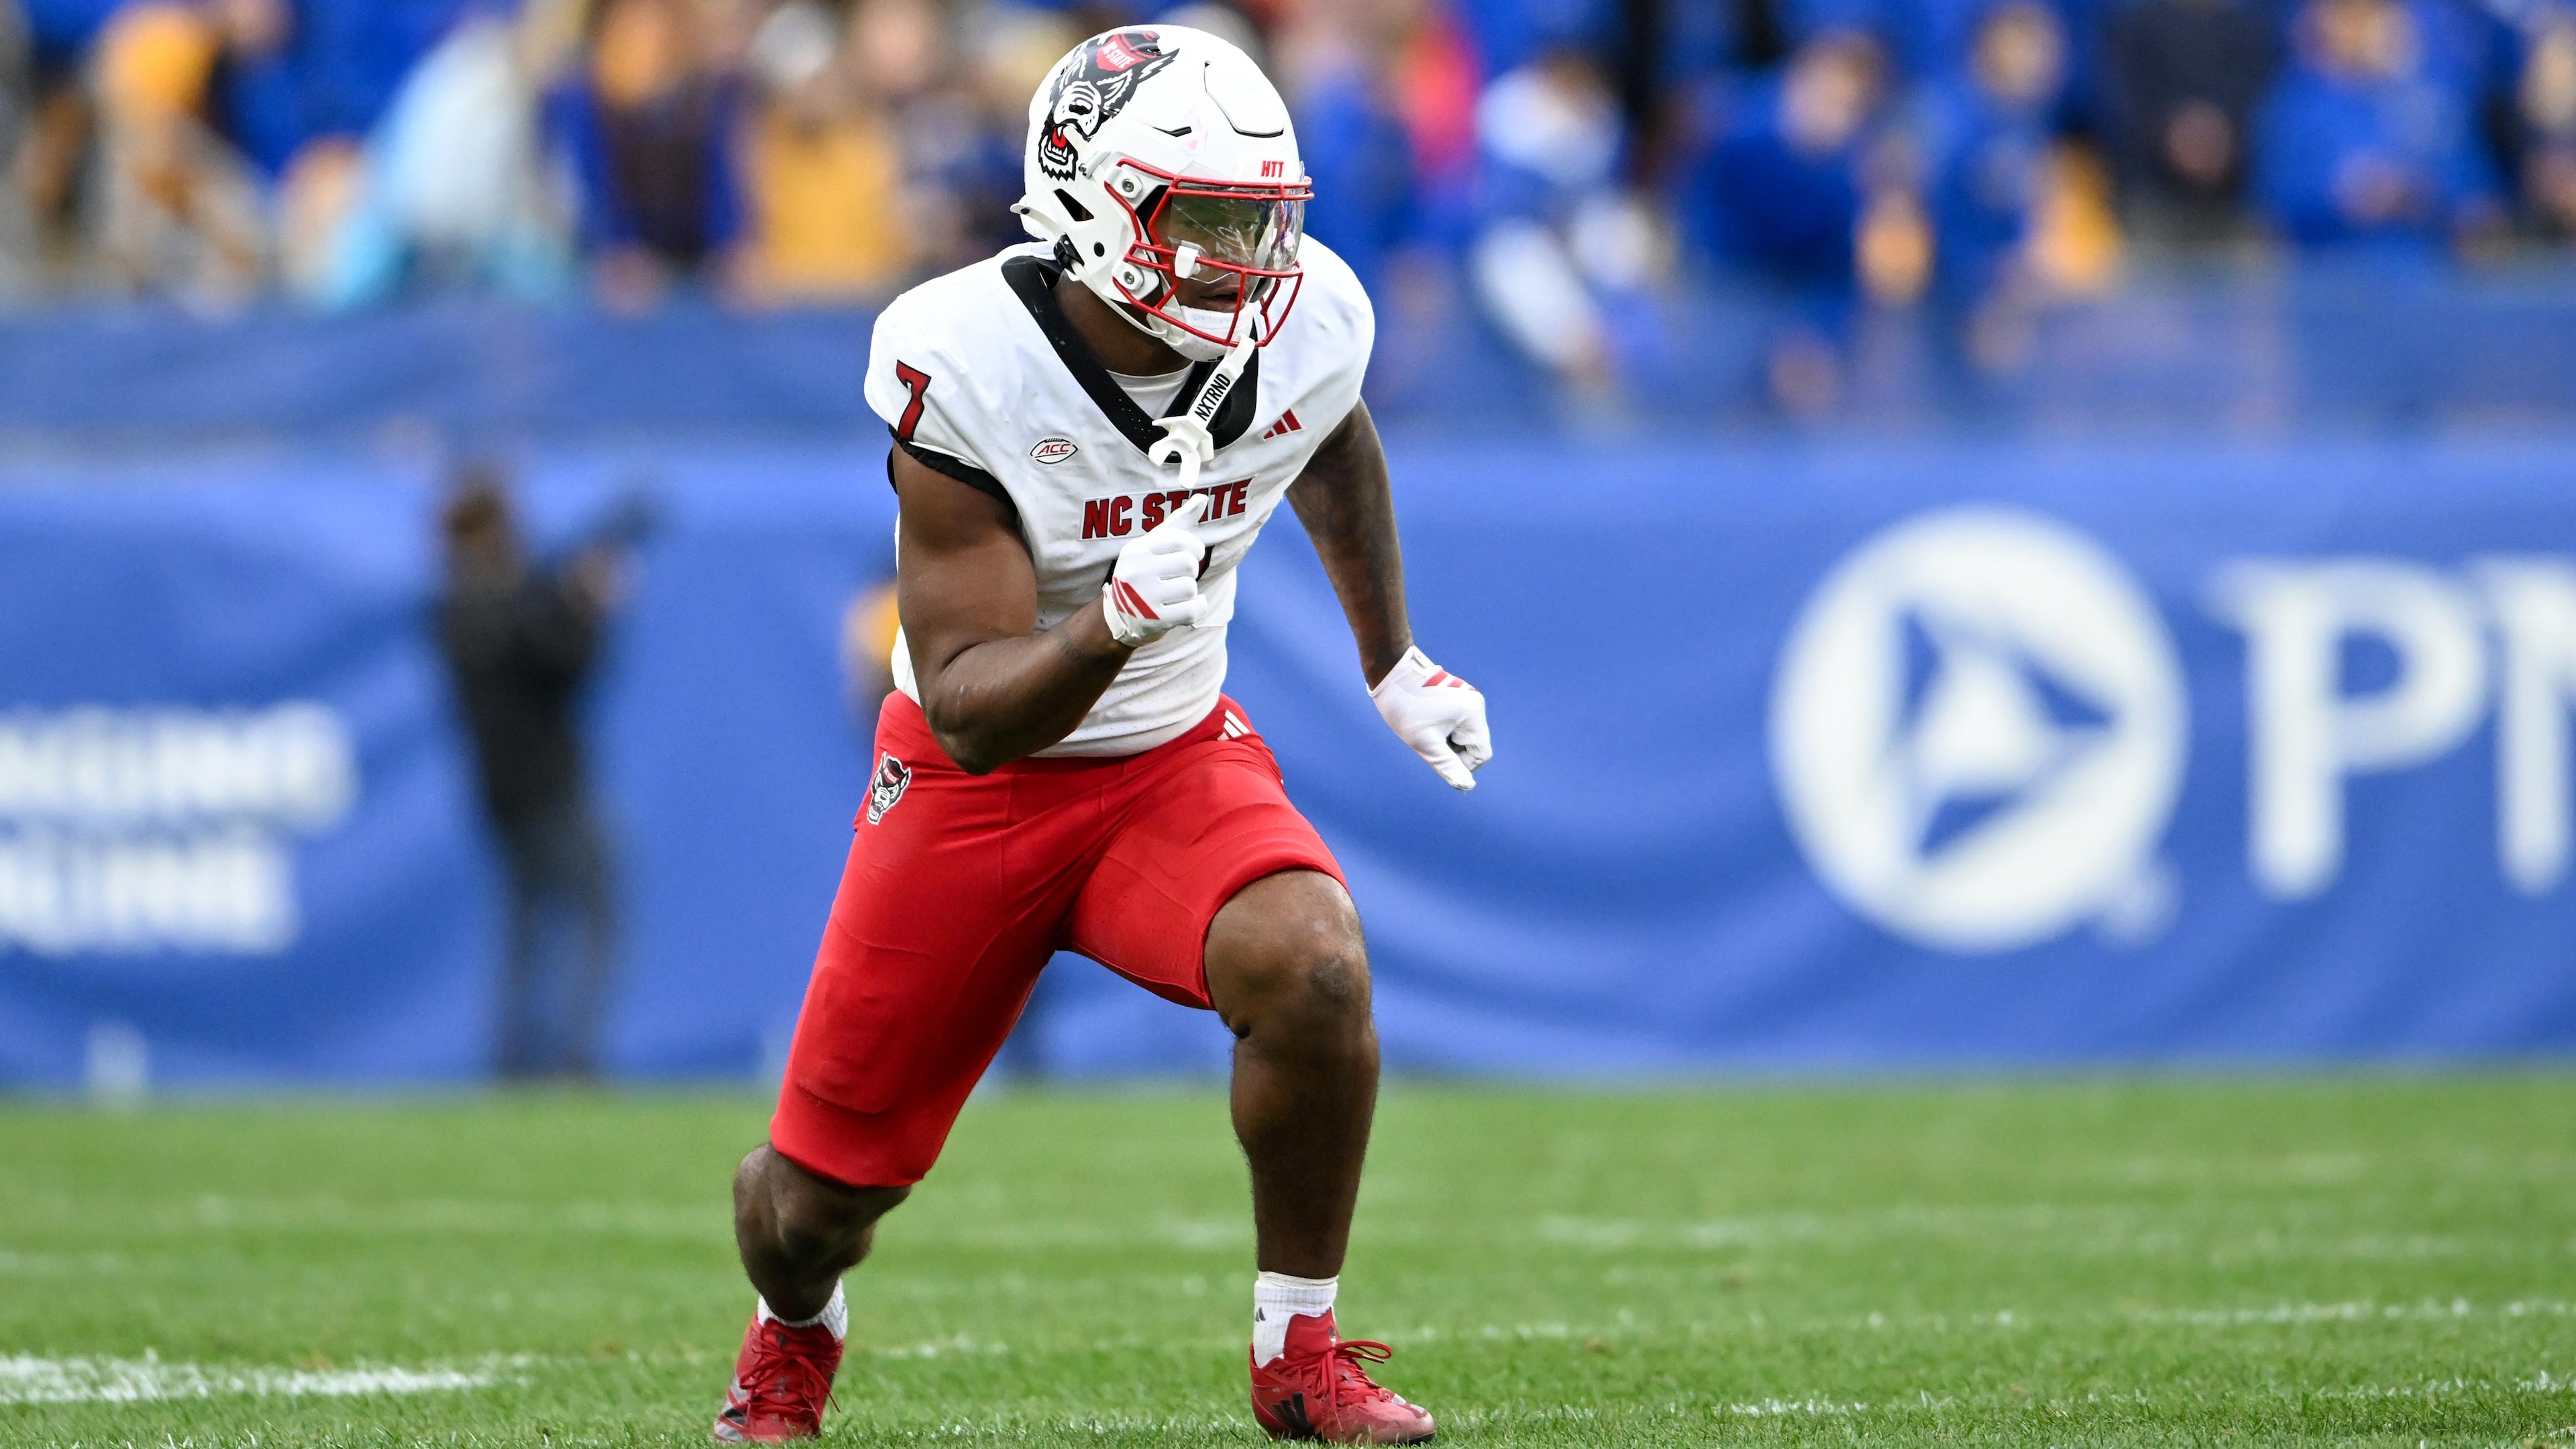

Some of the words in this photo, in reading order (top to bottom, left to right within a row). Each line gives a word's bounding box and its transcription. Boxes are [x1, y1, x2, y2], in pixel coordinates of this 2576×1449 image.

[1260, 160, 1284, 178] HTT
[896, 359, 932, 442] 7
[1194, 373, 1230, 421] NXTRND
[1037, 443, 1071, 455] ACC
[1082, 495, 1132, 539] NC
